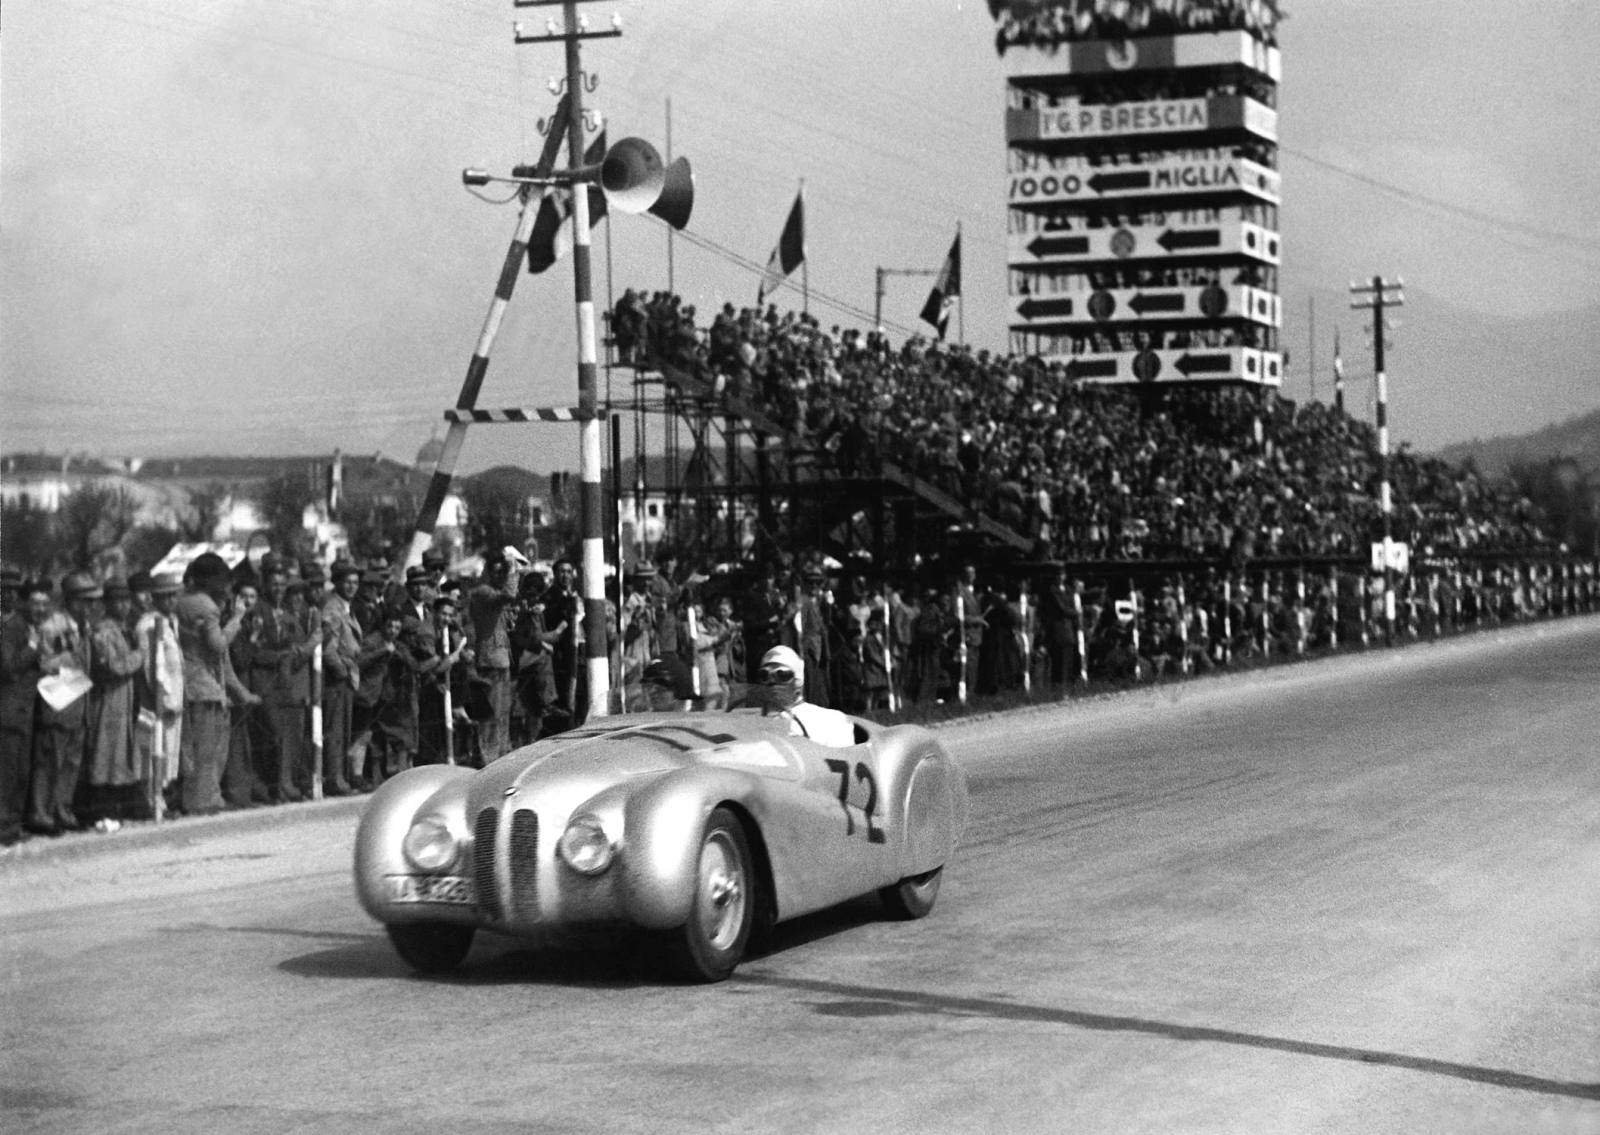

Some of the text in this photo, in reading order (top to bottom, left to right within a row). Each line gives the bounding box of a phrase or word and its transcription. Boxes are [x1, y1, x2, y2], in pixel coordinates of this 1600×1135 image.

[1101, 104, 1203, 131] BRESCIA
[1009, 164, 1240, 199] 1000 MIGLIA
[824, 758, 886, 844] 72
